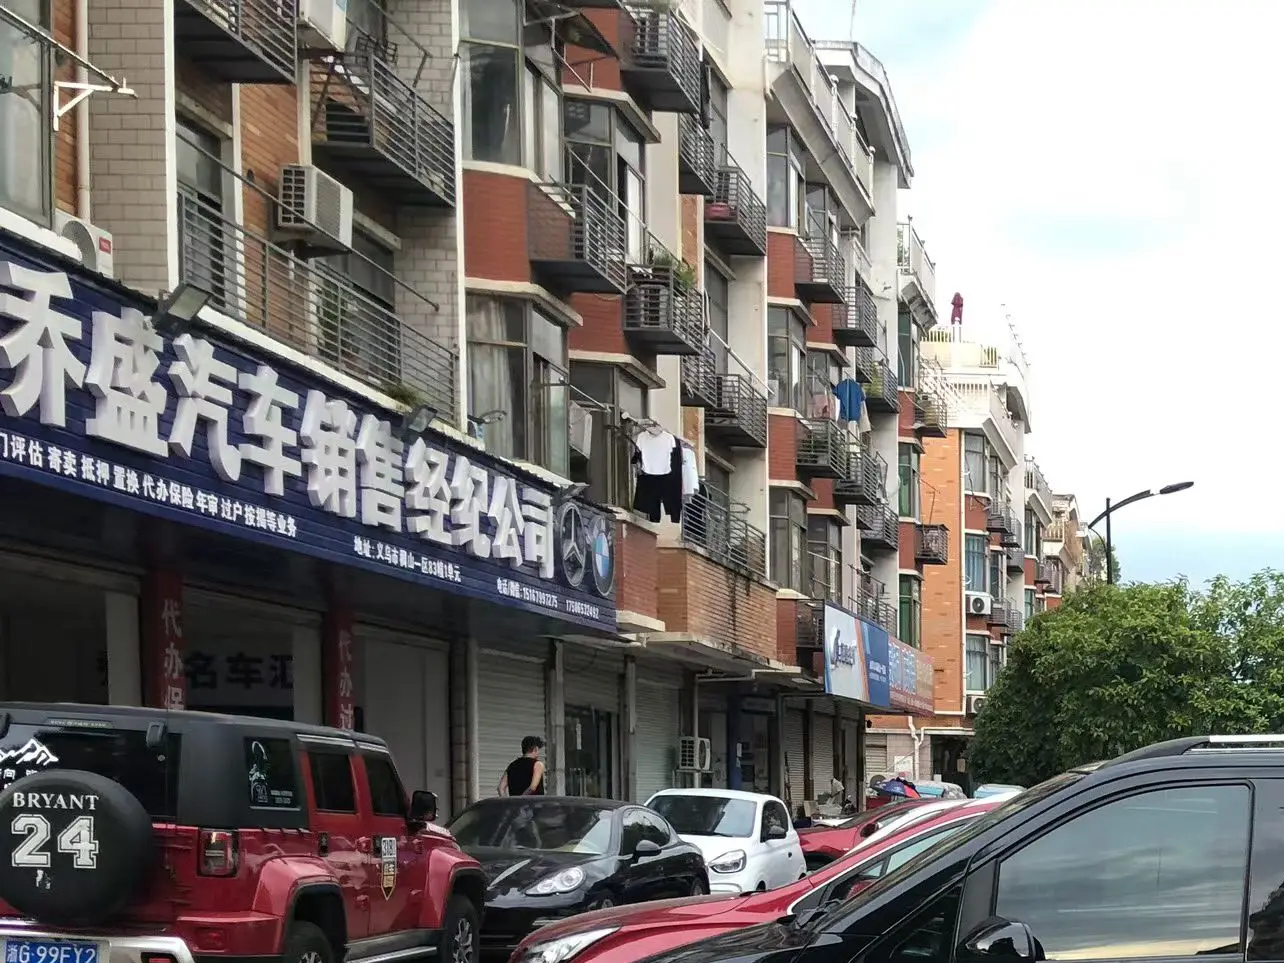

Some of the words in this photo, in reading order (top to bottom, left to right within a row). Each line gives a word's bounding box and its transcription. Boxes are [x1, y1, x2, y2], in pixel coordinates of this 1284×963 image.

[0, 261, 554, 578] 乔盛汽车销售经纪公司
[47, 445, 77, 478] 寄卖
[81, 454, 110, 486] 抵押
[113, 464, 140, 495] 置换
[142, 473, 195, 510] 代办保险
[13, 791, 98, 811] BRYANT
[11, 814, 98, 870] 24
